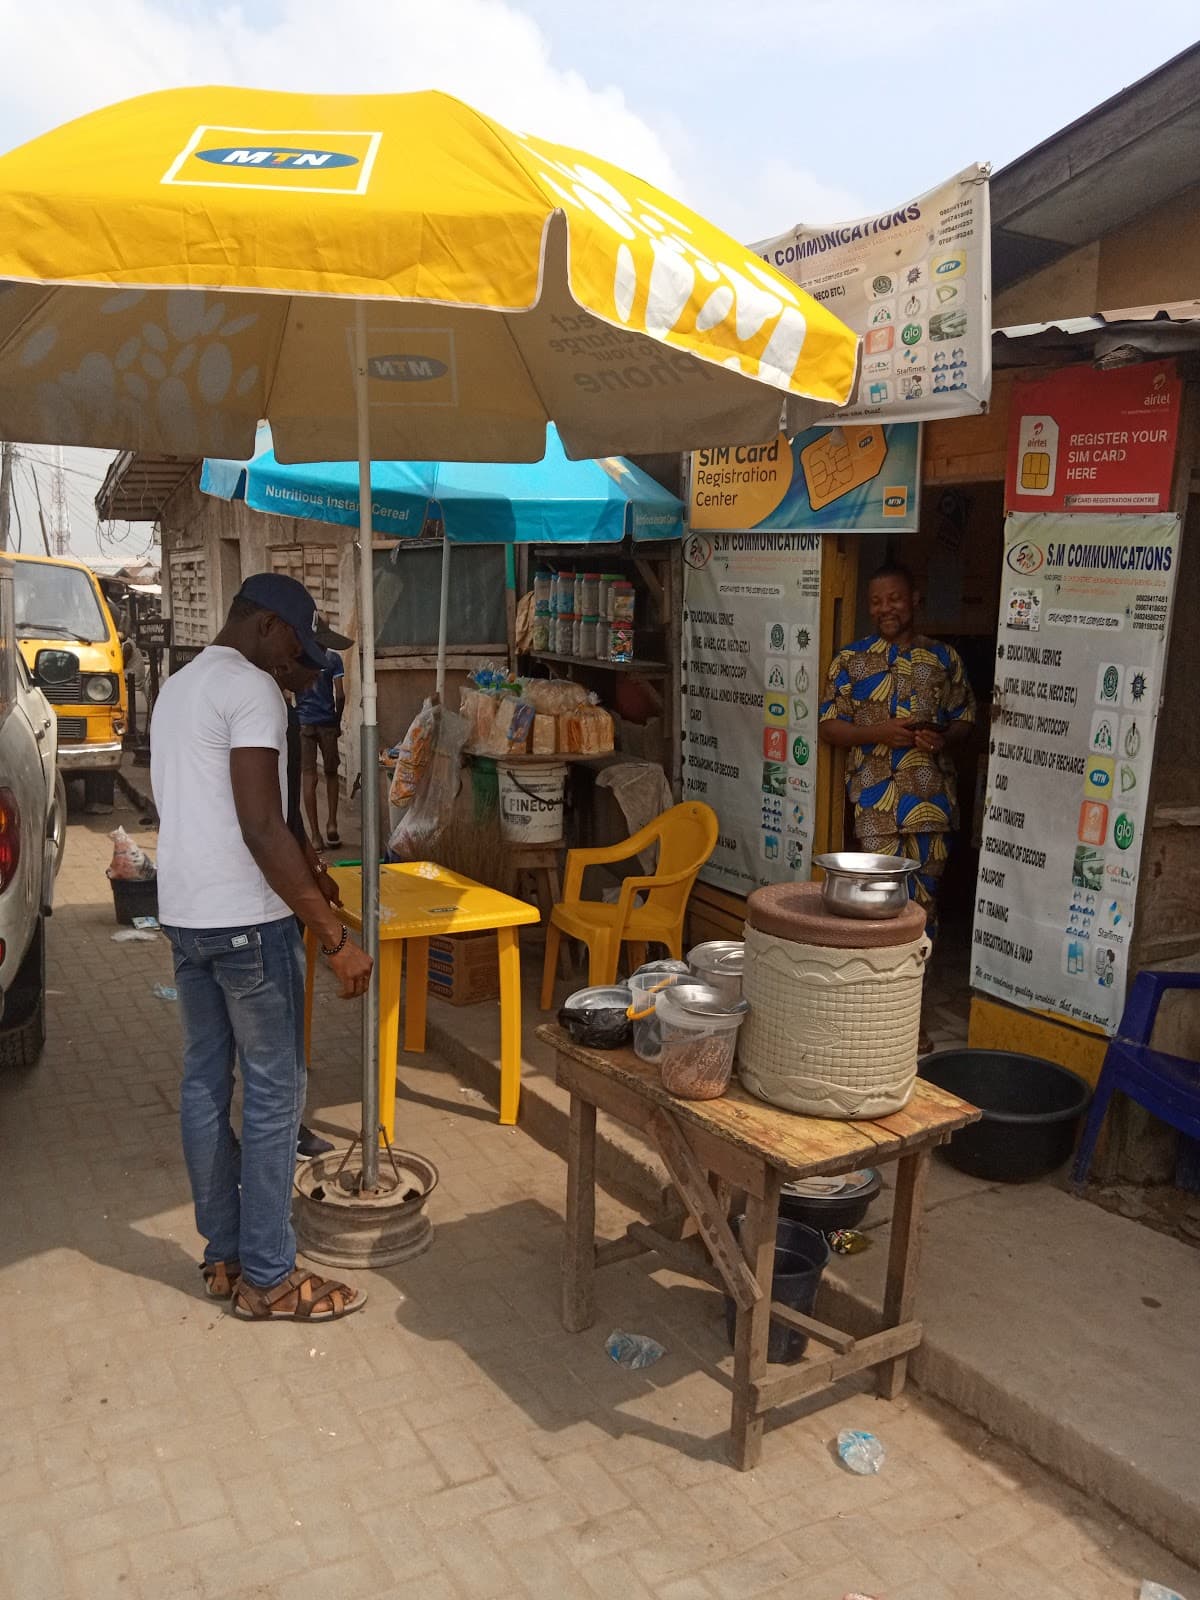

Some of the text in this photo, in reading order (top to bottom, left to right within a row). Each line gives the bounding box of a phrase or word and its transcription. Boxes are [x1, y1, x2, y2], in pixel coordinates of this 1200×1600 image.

[222, 150, 333, 165] MTN
[774, 202, 921, 267] COMMUNICATIONS
[940, 262, 955, 272] MTN
[904, 327, 919, 341] glo
[1144, 393, 1170, 405] airtel
[1027, 438, 1047, 448] airtel
[1070, 429, 1168, 446] REGISTER YOUR
[699, 439, 779, 466] SIM Card
[1068, 449, 1126, 463] SIM CARD
[697, 467, 777, 488] Registration
[1066, 467, 1097, 480] HERE
[266, 485, 410, 520] Nutritious Instan Cereal
[696, 491, 739, 507] Center
[1092, 496, 1131, 504] REGISTRATION
[714, 534, 820, 551] S.M COMMUNICATIONS
[1047, 543, 1172, 571] S.M COMMUNICATIONS
[1007, 645, 1062, 667] EDUCATIONAL SERVICE
[1050, 684, 1063, 702] NECO
[1038, 715, 1070, 736] PHOTOCOPY
[794, 742, 807, 758] glo
[1023, 747, 1032, 764] ALL
[1056, 754, 1085, 775] RECHARGE
[995, 774, 1008, 790] CARD
[1092, 773, 1108, 784] MTN
[989, 805, 1025, 830] CASH TRANSFER
[1116, 822, 1132, 841] glo
[985, 836, 1015, 861] RECHARGING
[1022, 848, 1047, 869] DECODER
[987, 901, 1009, 923] TRAINING
[1098, 927, 1125, 944] StarTimes
[983, 931, 1013, 958] REGISTRATION
